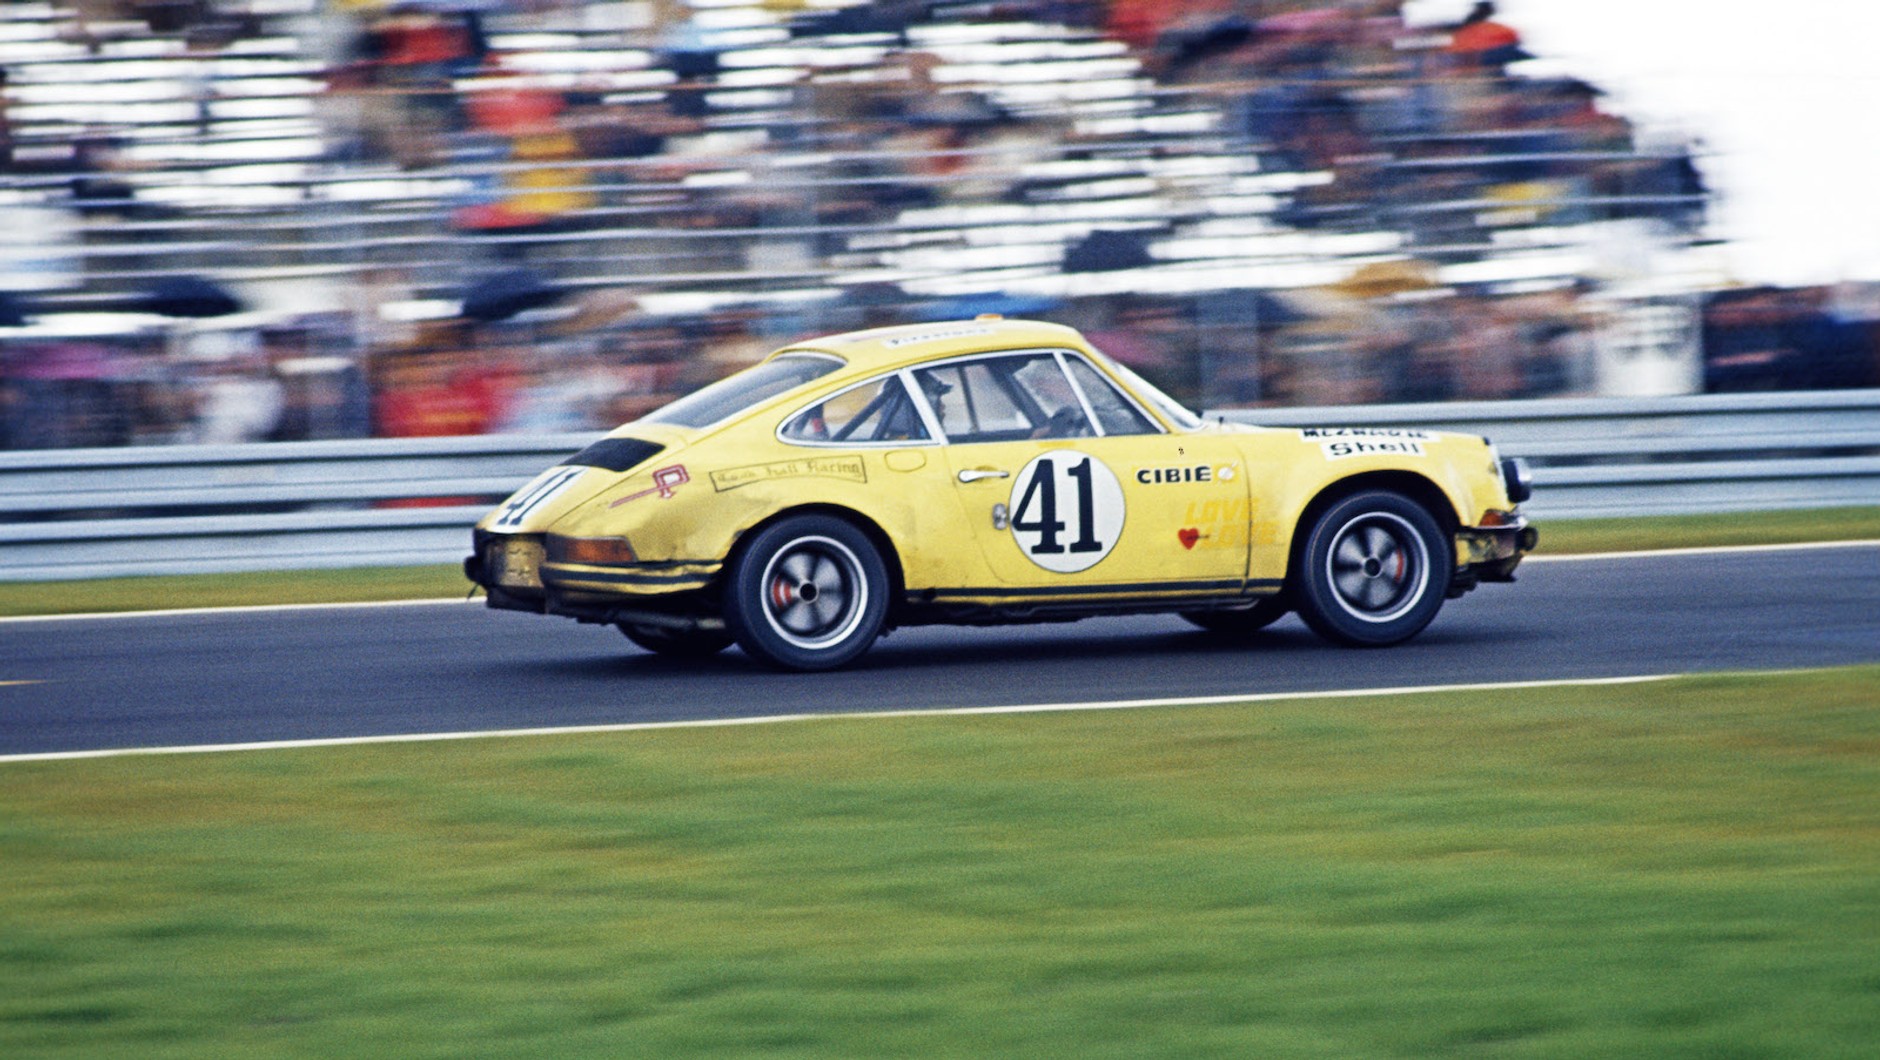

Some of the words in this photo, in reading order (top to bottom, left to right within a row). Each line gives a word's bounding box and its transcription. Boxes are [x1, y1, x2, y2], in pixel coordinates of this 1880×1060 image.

[1329, 442, 1419, 456] Shell
[1136, 465, 1212, 485] CIBIE
[497, 467, 586, 526] 41
[1011, 457, 1103, 555] 41
[1184, 497, 1260, 526] LOVE
